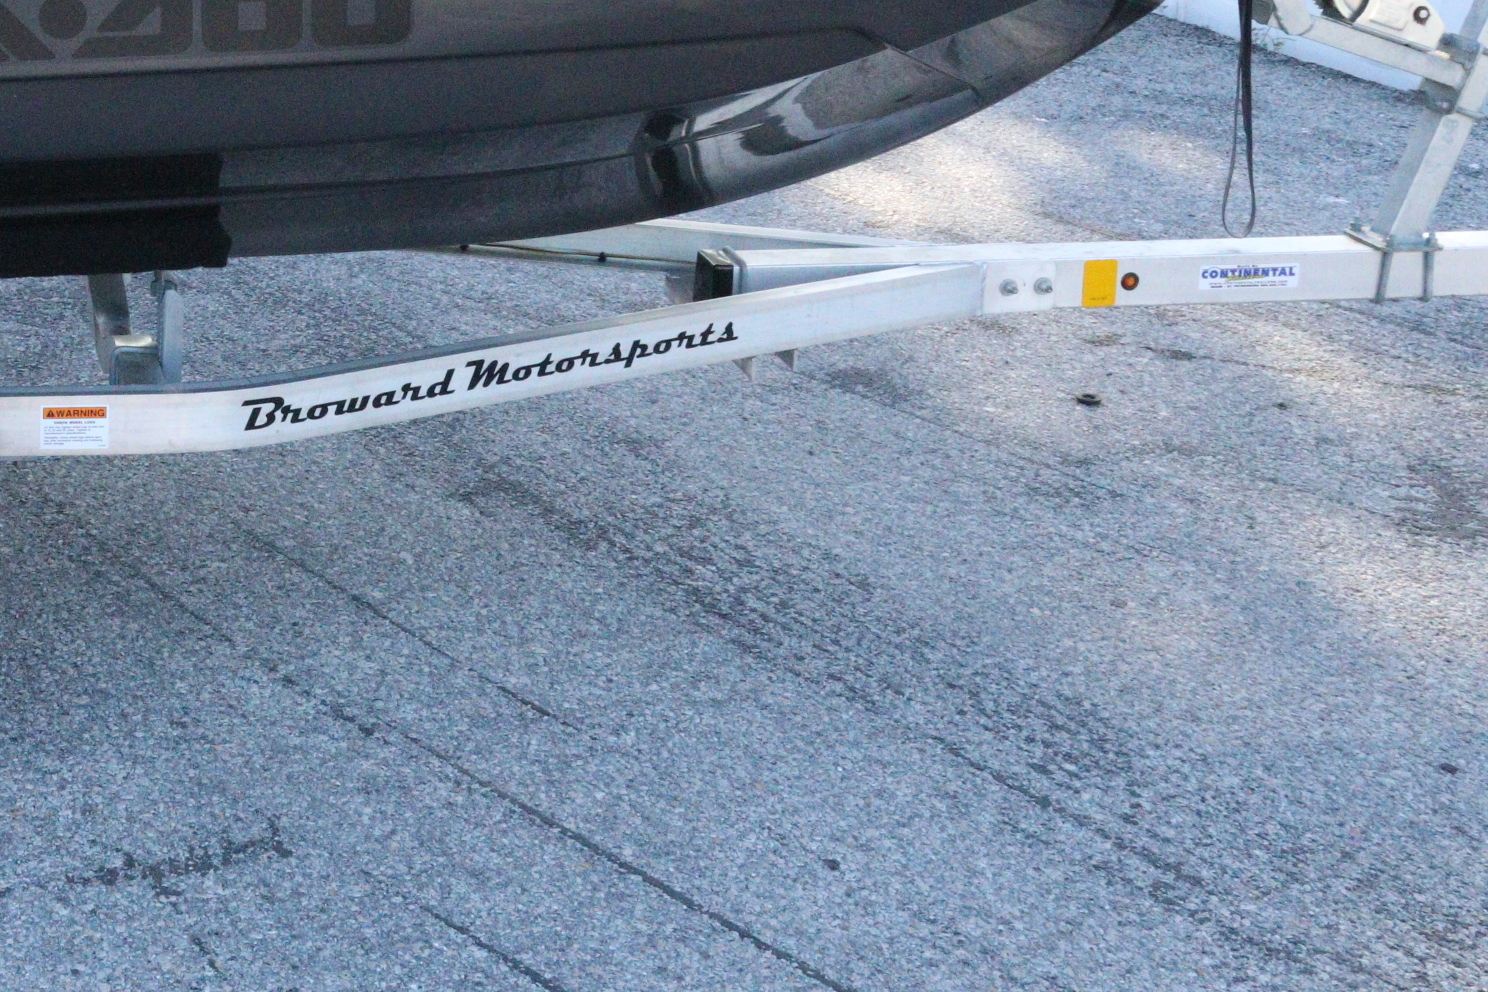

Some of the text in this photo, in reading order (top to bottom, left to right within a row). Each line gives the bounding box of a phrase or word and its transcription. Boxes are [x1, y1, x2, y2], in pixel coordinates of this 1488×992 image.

[1201, 267, 1296, 279] CONTINENTAL
[242, 321, 739, 431] Broward Motorsports
[56, 409, 105, 418] WARNING
